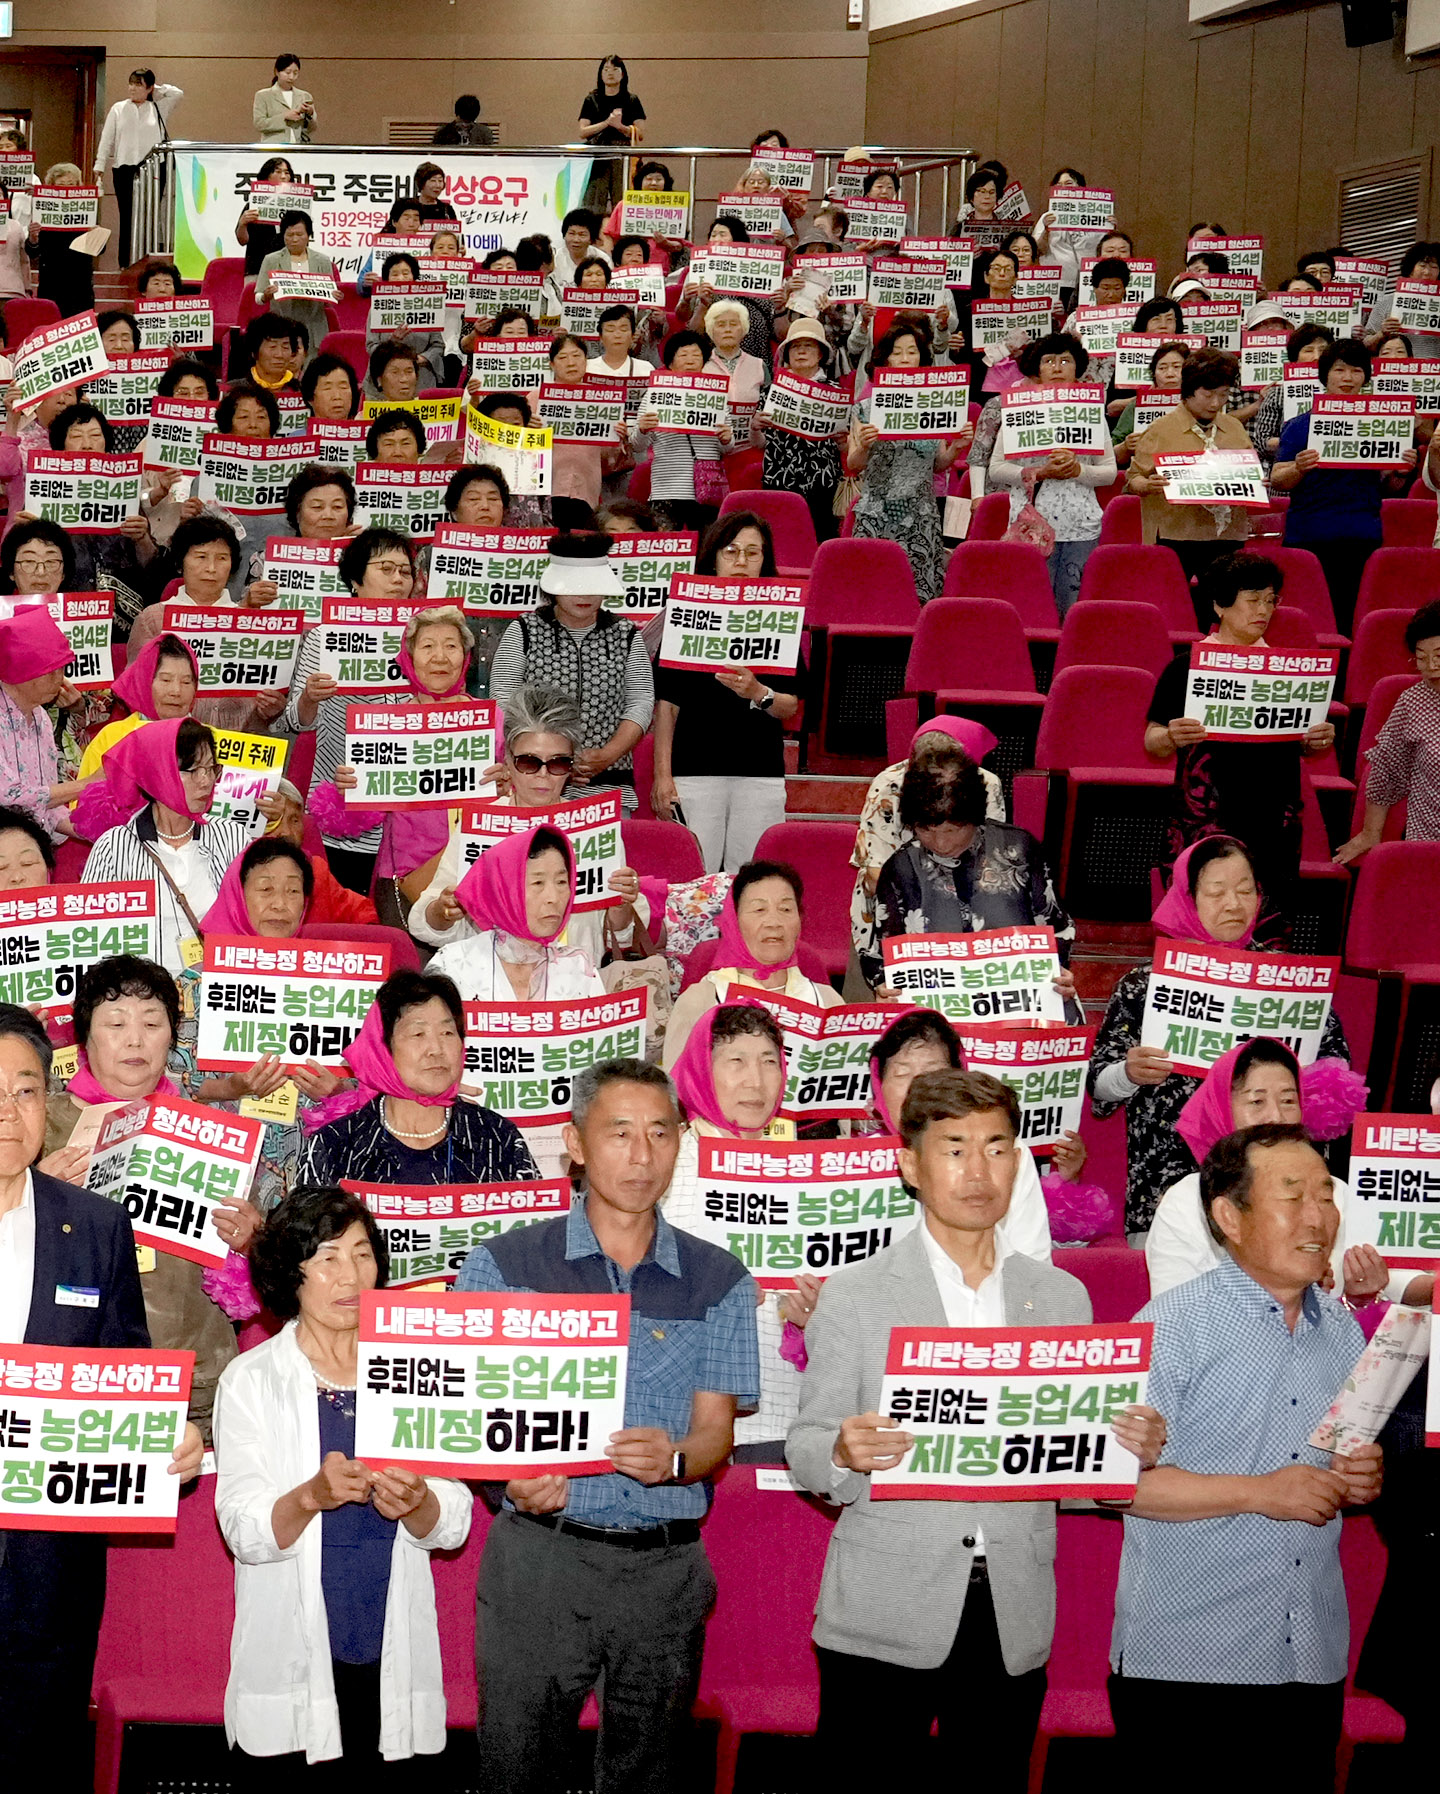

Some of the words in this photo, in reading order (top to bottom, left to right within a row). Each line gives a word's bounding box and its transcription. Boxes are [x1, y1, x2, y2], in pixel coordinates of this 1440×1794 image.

[234, 172, 336, 203] 주군
[343, 174, 419, 203] 주둔비
[60, 200, 96, 213] 농업4법
[626, 207, 683, 220] 모든농민에게
[1077, 201, 1112, 214] 농업4법
[40, 212, 89, 226] 제정하라!
[321, 211, 389, 228] 5192억원
[624, 220, 682, 235] 농민수당을!
[1057, 214, 1107, 226] 제정하라!
[320, 232, 352, 249] 13조
[440, 403, 456, 419] 주체
[1318, 399, 1365, 413] 내란농정
[1367, 400, 1413, 414] 청산하고
[1313, 419, 1354, 437] 후퇴없는
[1356, 419, 1412, 438] 농업4법
[526, 433, 546, 448] 주체
[1323, 440, 1400, 459] 제정하라!
[677, 581, 740, 600] 내란농정
[742, 585, 801, 603] 청산하고
[670, 608, 722, 631] 후퇴없는
[725, 609, 798, 634] 농업4법
[680, 635, 781, 660] 제정하라!
[1198, 651, 1265, 670] 내란농정
[1268, 655, 1332, 674] 청산하고
[1191, 677, 1247, 701] 후퇴없는
[1251, 679, 1329, 704] 농업4법
[355, 711, 422, 730] 내란농정
[426, 710, 490, 729] 청산하고
[1204, 705, 1311, 729] 제정하라!
[214, 738, 246, 763] 업의
[248, 743, 277, 768] 주체
[351, 741, 408, 766] 후퇴없는
[412, 736, 490, 764] 농업4법
[366, 767, 476, 797] 제정하라!
[53, 1061, 76, 1076] 이영
[375, 1305, 493, 1337] 내란농정
[502, 1308, 618, 1339] 청산하고
[70, 1361, 180, 1395] 청산하고
[366, 1356, 466, 1397] 후퇴없는
[475, 1355, 617, 1400] 농업4법
[40, 1408, 177, 1455] 농업4법
[393, 1407, 590, 1453] 제정하라!
